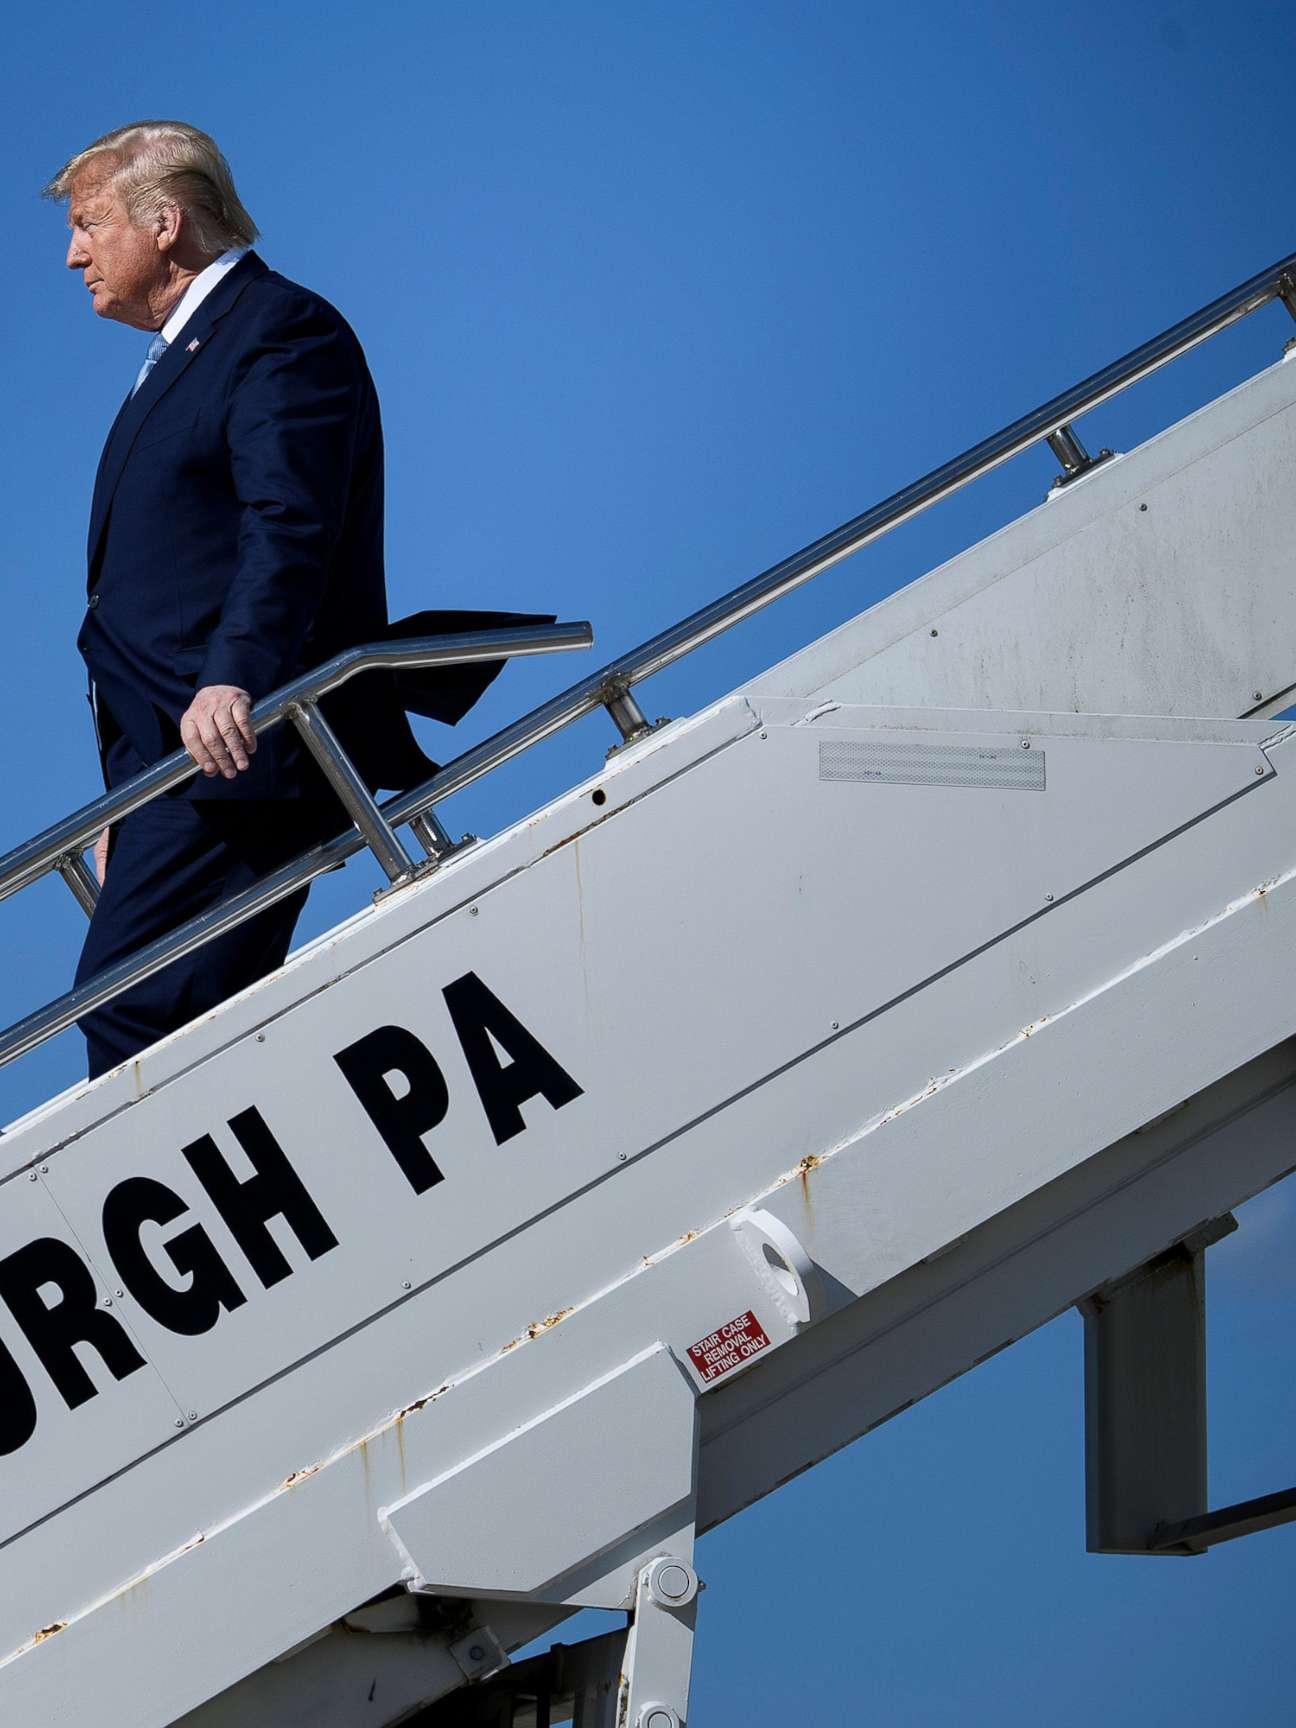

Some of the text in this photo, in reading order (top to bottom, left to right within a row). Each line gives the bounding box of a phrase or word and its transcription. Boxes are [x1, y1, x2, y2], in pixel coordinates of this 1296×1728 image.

[333, 971, 585, 1196] PA
[692, 1314, 751, 1357] STAIR CASE
[701, 1334, 766, 1382] LIFTING ONLY
[703, 1331, 752, 1365] REMOVAL
